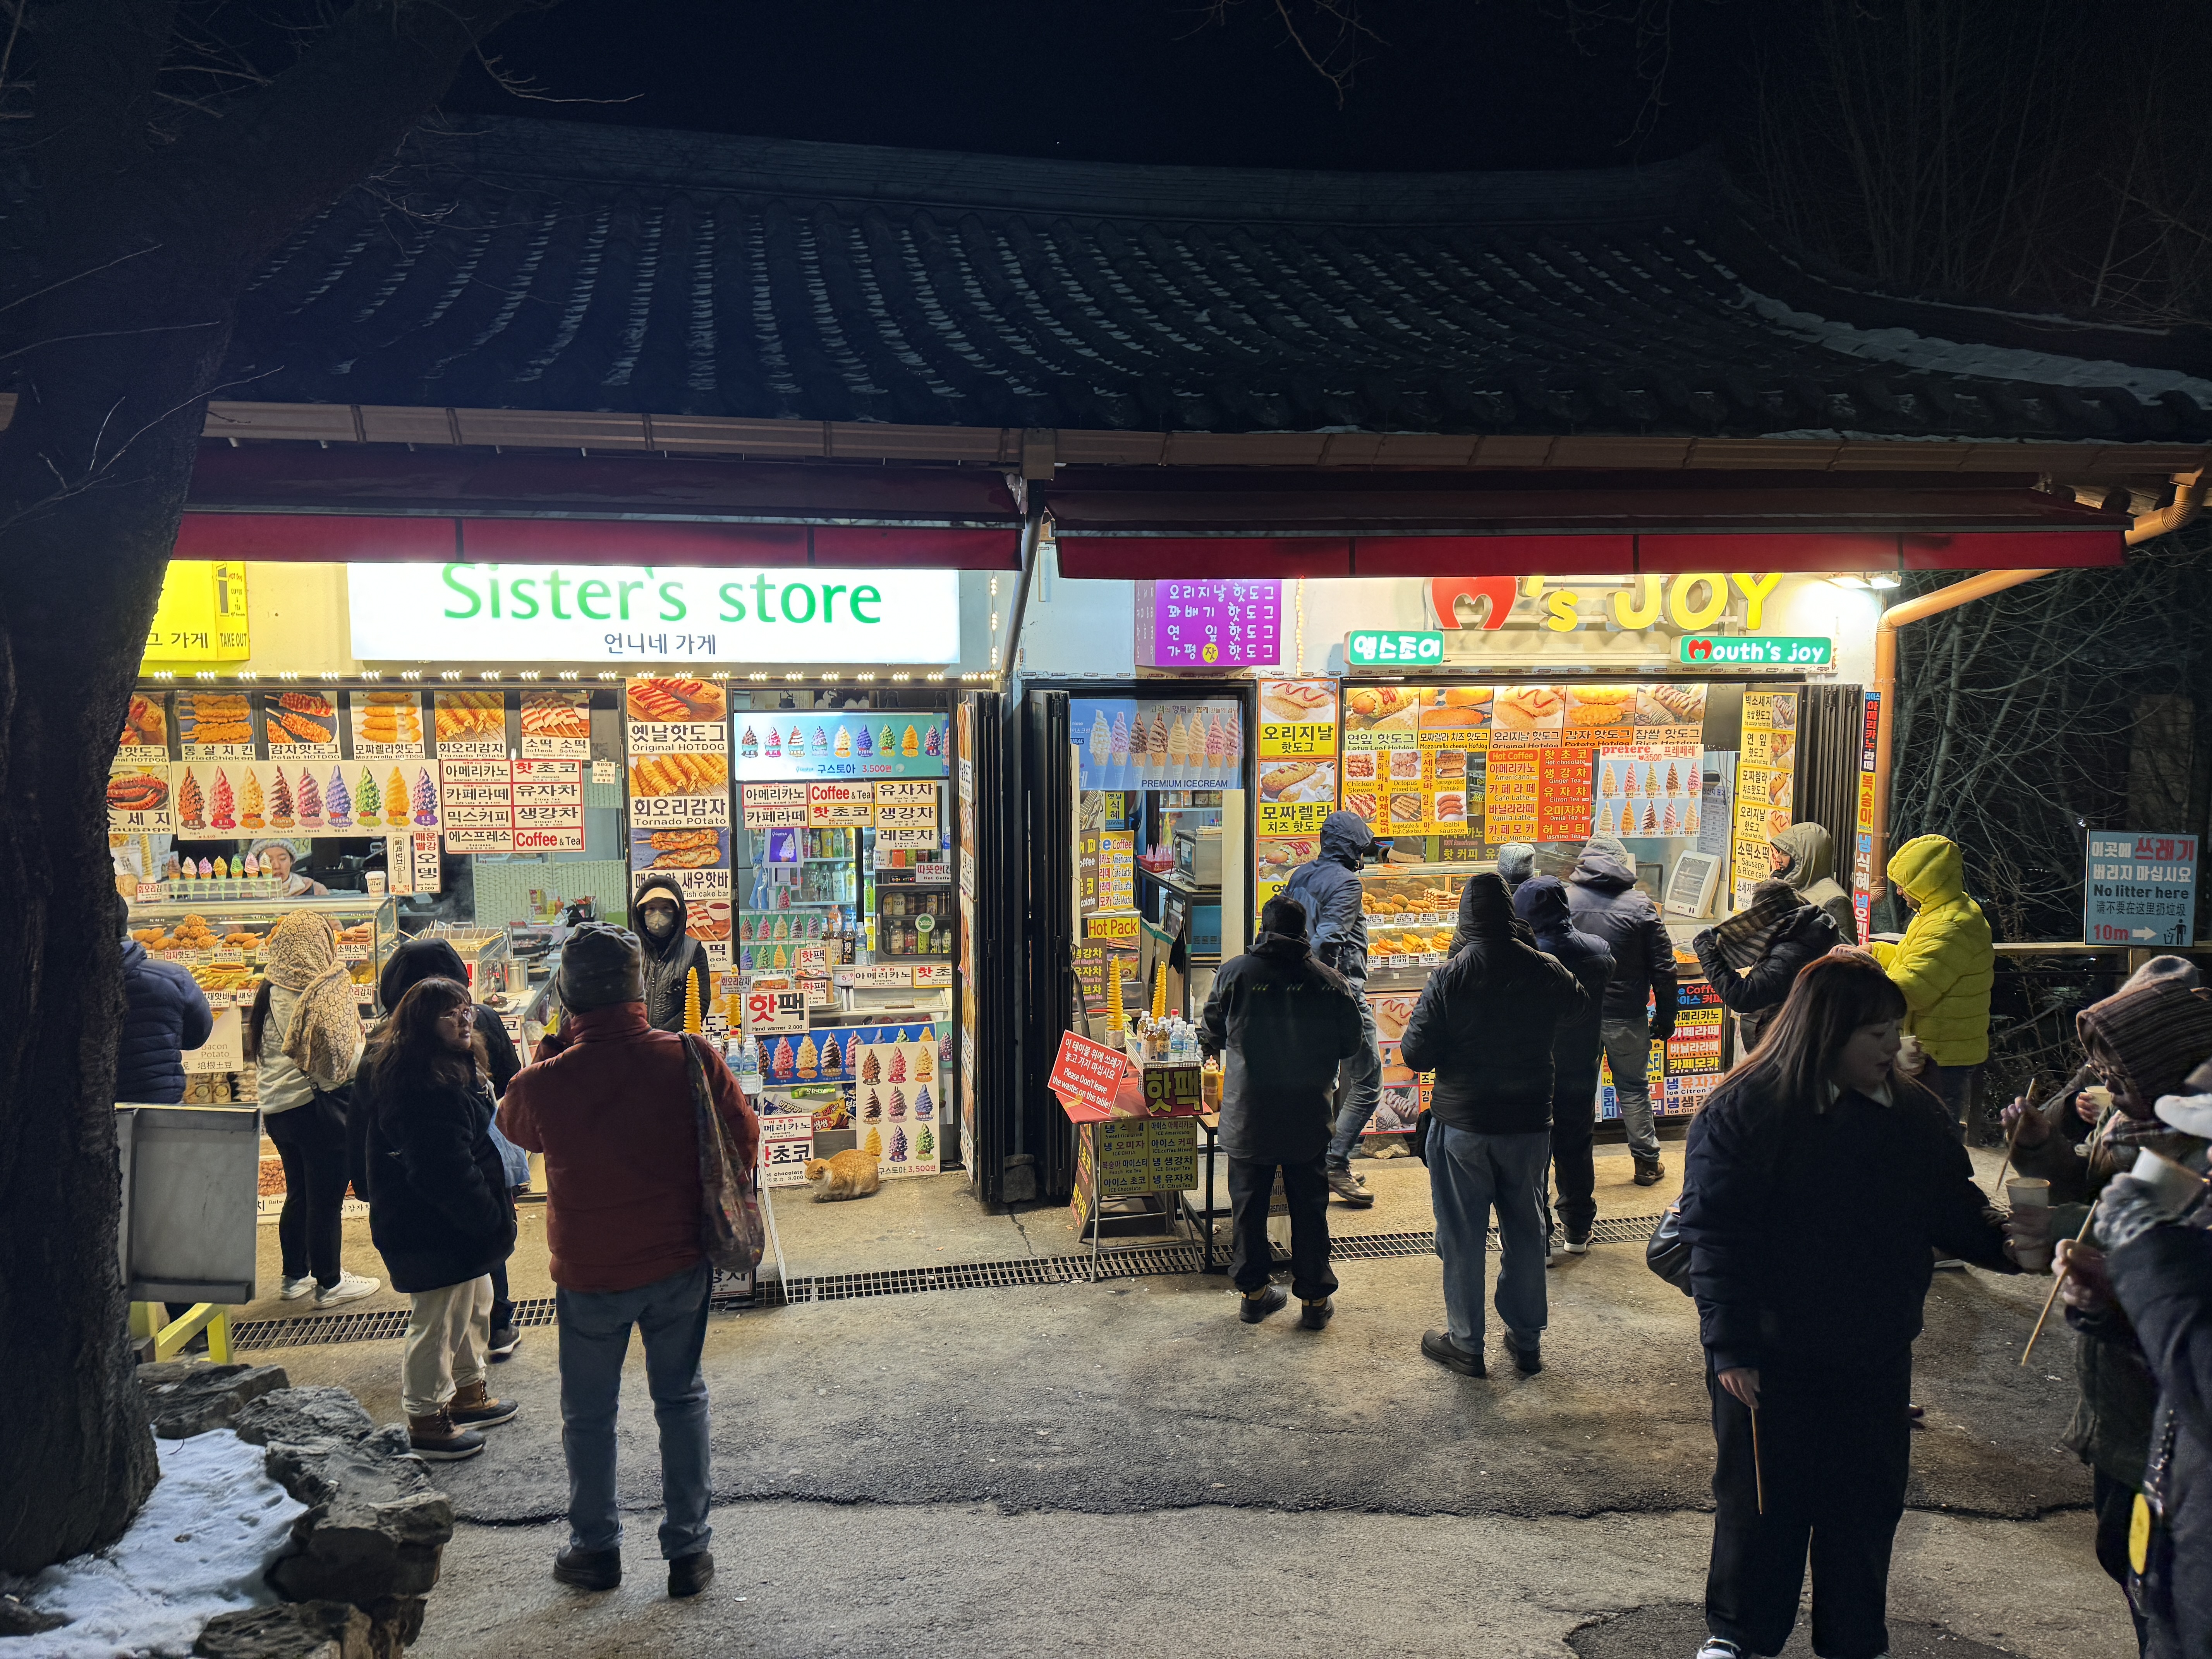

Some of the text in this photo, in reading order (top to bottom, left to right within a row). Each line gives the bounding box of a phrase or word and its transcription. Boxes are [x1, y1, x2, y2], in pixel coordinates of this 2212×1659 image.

[442, 563, 881, 624] Sister's store
[1170, 583, 1274, 602] 오리지날 핫도그
[1228, 602, 1273, 622] 핫도그
[1228, 622, 1273, 641] 핫도그
[171, 632, 208, 649] 가게
[220, 633, 247, 647] TAKE OUT
[605, 634, 716, 654] 언니네 가게
[1228, 641, 1273, 661] 핫도그
[1787, 642, 1824, 663] joy
[1746, 695, 1772, 707] 빅소세지
[632, 725, 725, 742] 옛날핫도그
[1263, 725, 1333, 741] 오리지날
[1347, 733, 1415, 744] 연잎 핫도그
[1420, 732, 1487, 742] 모짜렐라 치즈 핫도그
[1494, 730, 1559, 742] 오리지날 핫도그
[1565, 729, 1630, 740] 감자 핫도그
[1636, 729, 1699, 740] 찹쌀 핫도그
[271, 744, 340, 754] 감자핫도그
[356, 744, 423, 754] 모짜렐라핫도그
[439, 743, 503, 753] 회오리감자
[632, 744, 674, 752] Original
[1281, 742, 1314, 753] 핫도그
[446, 765, 508, 777] 아메리카노
[817, 764, 855, 774] 구스토아
[1490, 763, 1535, 774] 아메리카노
[447, 788, 508, 800] 카페라떼
[516, 785, 577, 797] 유자차
[746, 788, 805, 800] 아메리카노
[812, 785, 871, 800] Coffee Tea
[879, 784, 933, 796] 유자차
[1860, 775, 1873, 824] 복숭아
[518, 807, 578, 819] 생강차
[634, 799, 726, 817] 회오리감자
[879, 807, 934, 820] 생강차
[1489, 803, 1535, 814] 바닐라라떼
[1543, 805, 1586, 816] 오미자차
[448, 811, 508, 823] 믹스커피
[747, 811, 805, 823] 카페라떼
[1740, 807, 1765, 822] 오리지날
[1267, 821, 1289, 833] 치즈
[416, 833, 436, 841] 매운
[449, 831, 511, 842] 에스프레소
[516, 832, 580, 847] Coffee Tea
[880, 830, 934, 841] 레몬차
[1112, 839, 1132, 850] Coffee
[2092, 836, 2195, 862] 이곳에 쓰레기
[1738, 842, 1769, 863] 소떡소떡
[1742, 857, 1764, 870] Sausage
[1743, 867, 1754, 877] Rice
[2136, 865, 2191, 883] 마십시요
[682, 871, 728, 889] 새우핫바
[2094, 884, 2189, 899] No litter here
[1089, 918, 1137, 936] Hot Pack
[2094, 924, 2129, 941] 10m
[802, 949, 824, 962] 핫팩
[749, 993, 804, 1024] 핫팩
[1670, 1042, 1719, 1053] 바닐라라떼
[1065, 1038, 1123, 1071] 이 테이블 위에 쓰레기
[198, 1061, 232, 1069] 培根土豆
[1670, 1057, 1719, 1069] 카페모카
[1091, 1061, 1116, 1080] 마십시요
[1063, 1067, 1080, 1082] Please
[1093, 1080, 1108, 1094] leave
[1052, 1075, 1112, 1109] the wastes on this table!
[1146, 1070, 1200, 1113] 핫팩
[1116, 1140, 1145, 1150] 오미자
[1123, 1158, 1148, 1168] 아이스티
[1164, 1173, 1194, 1184] 유자차
